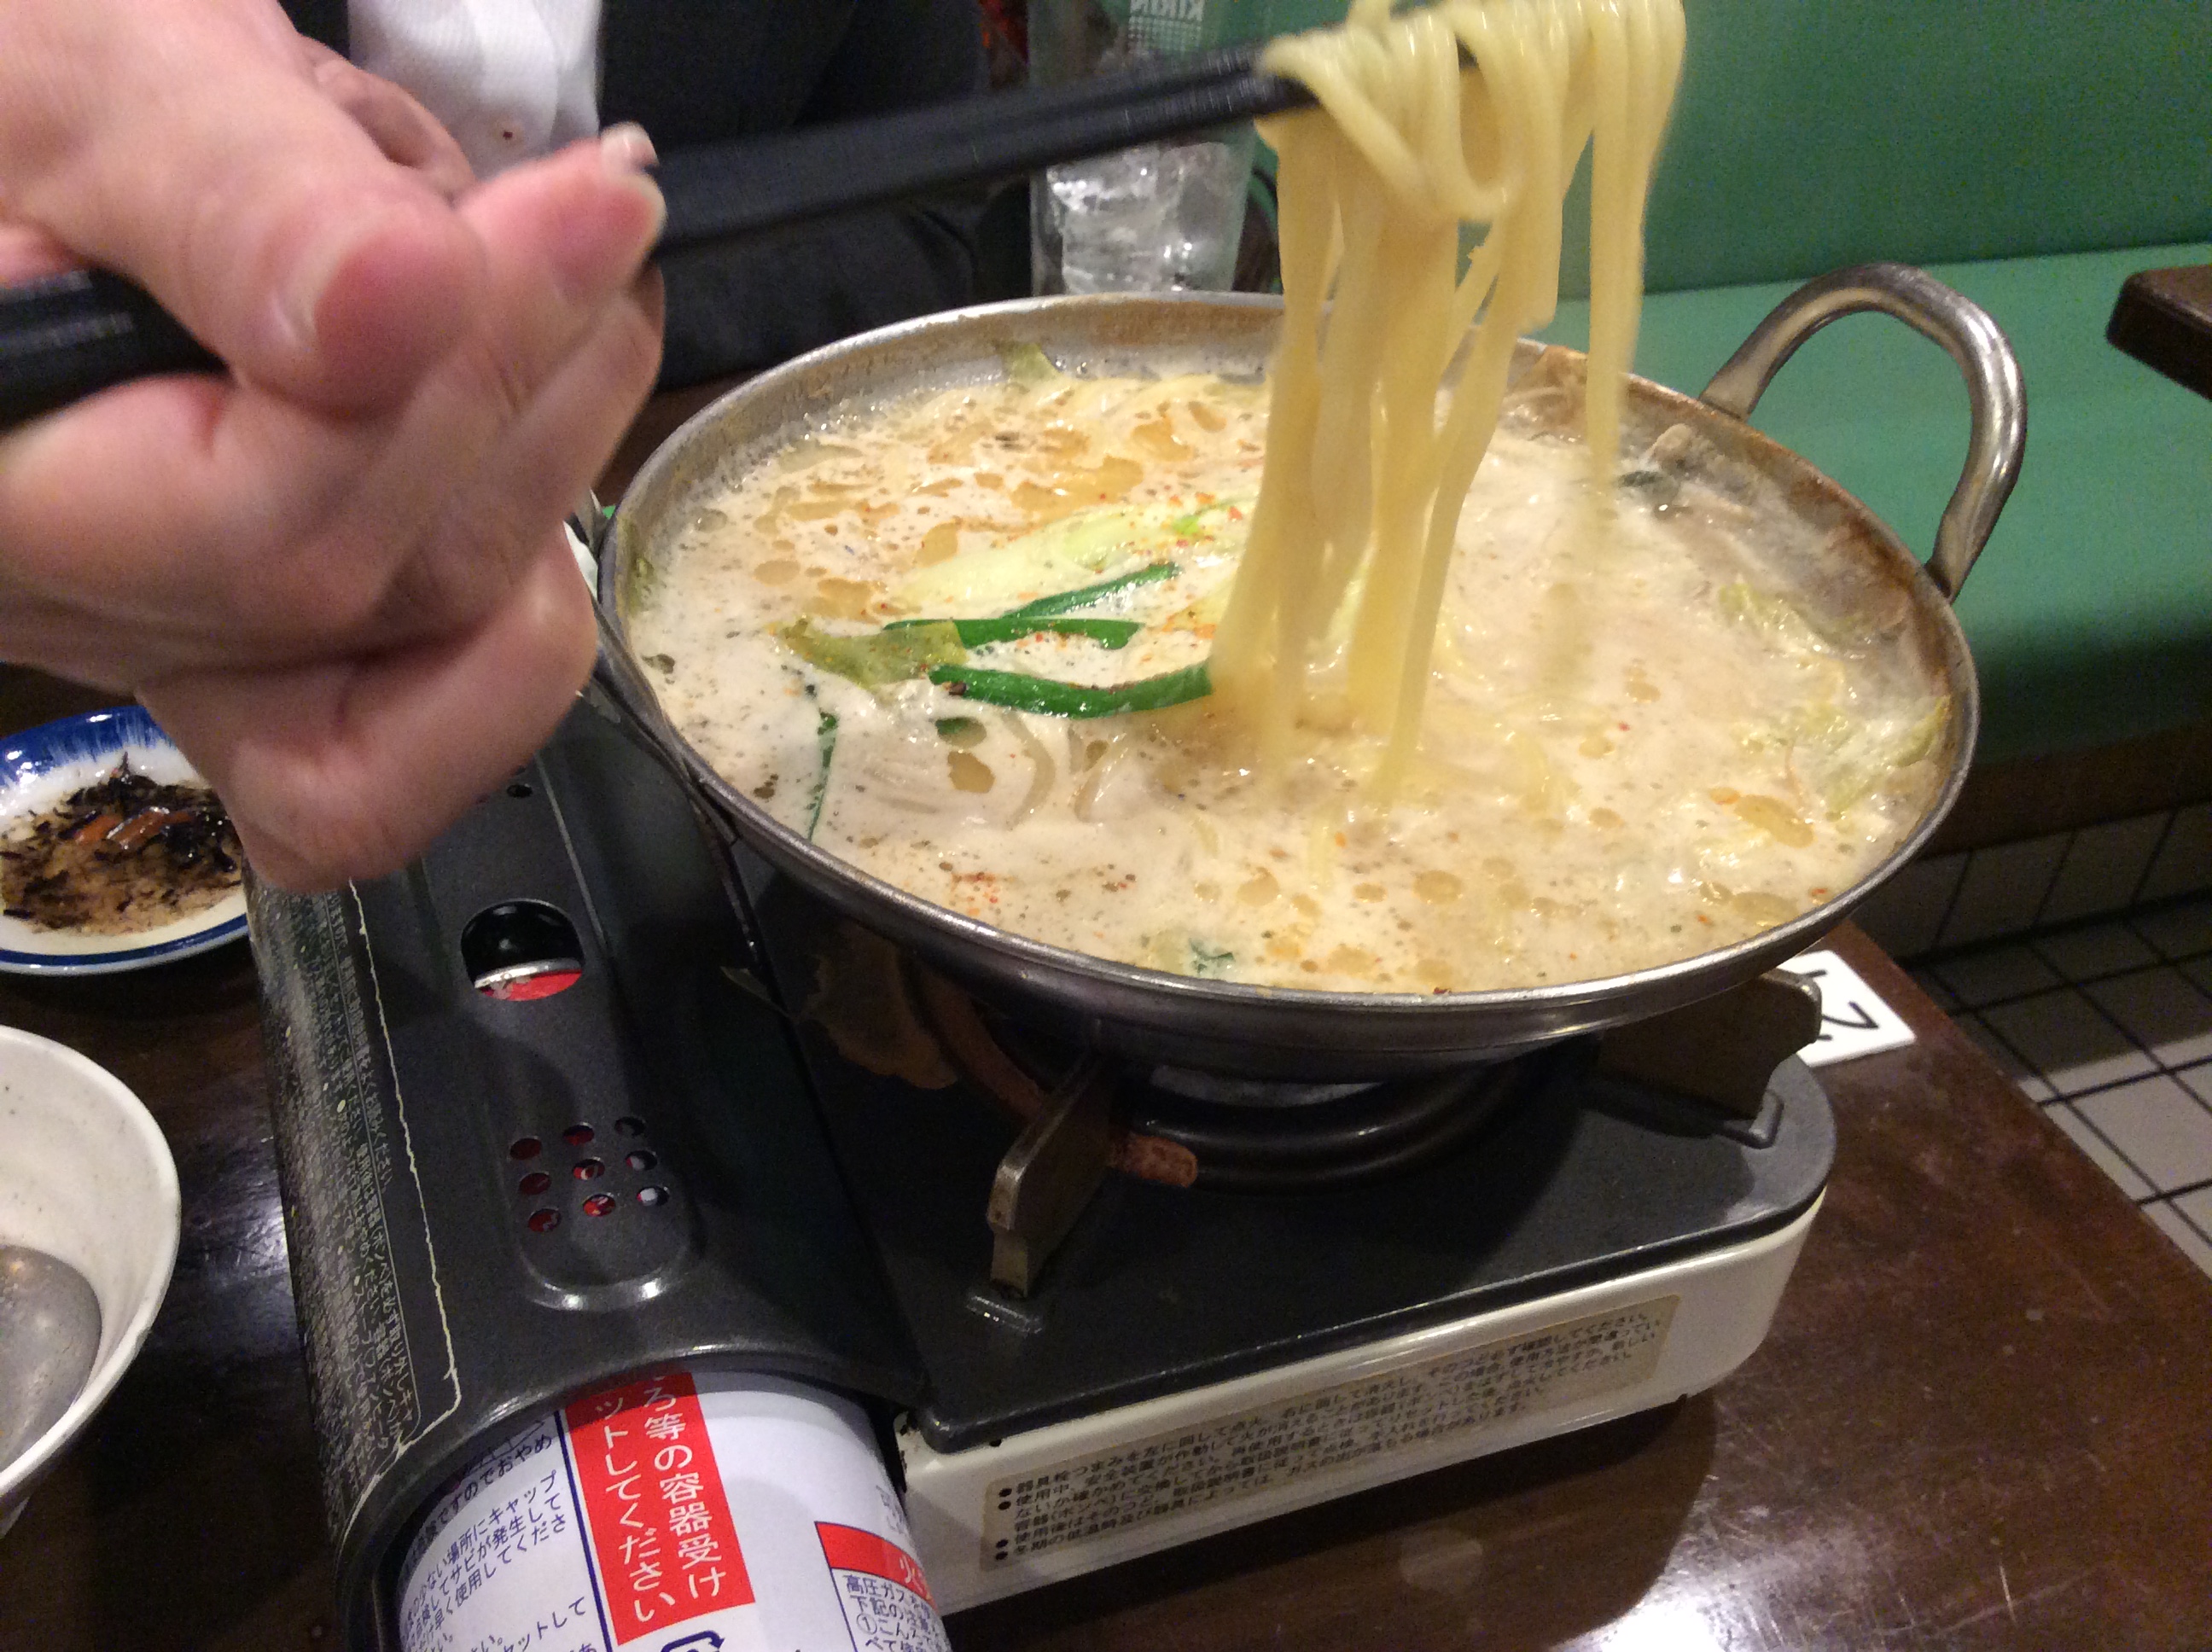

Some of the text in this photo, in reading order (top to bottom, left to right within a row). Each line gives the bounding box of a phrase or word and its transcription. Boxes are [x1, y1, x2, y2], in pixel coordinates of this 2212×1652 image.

[596, 1397, 674, 1623] ットしてください
